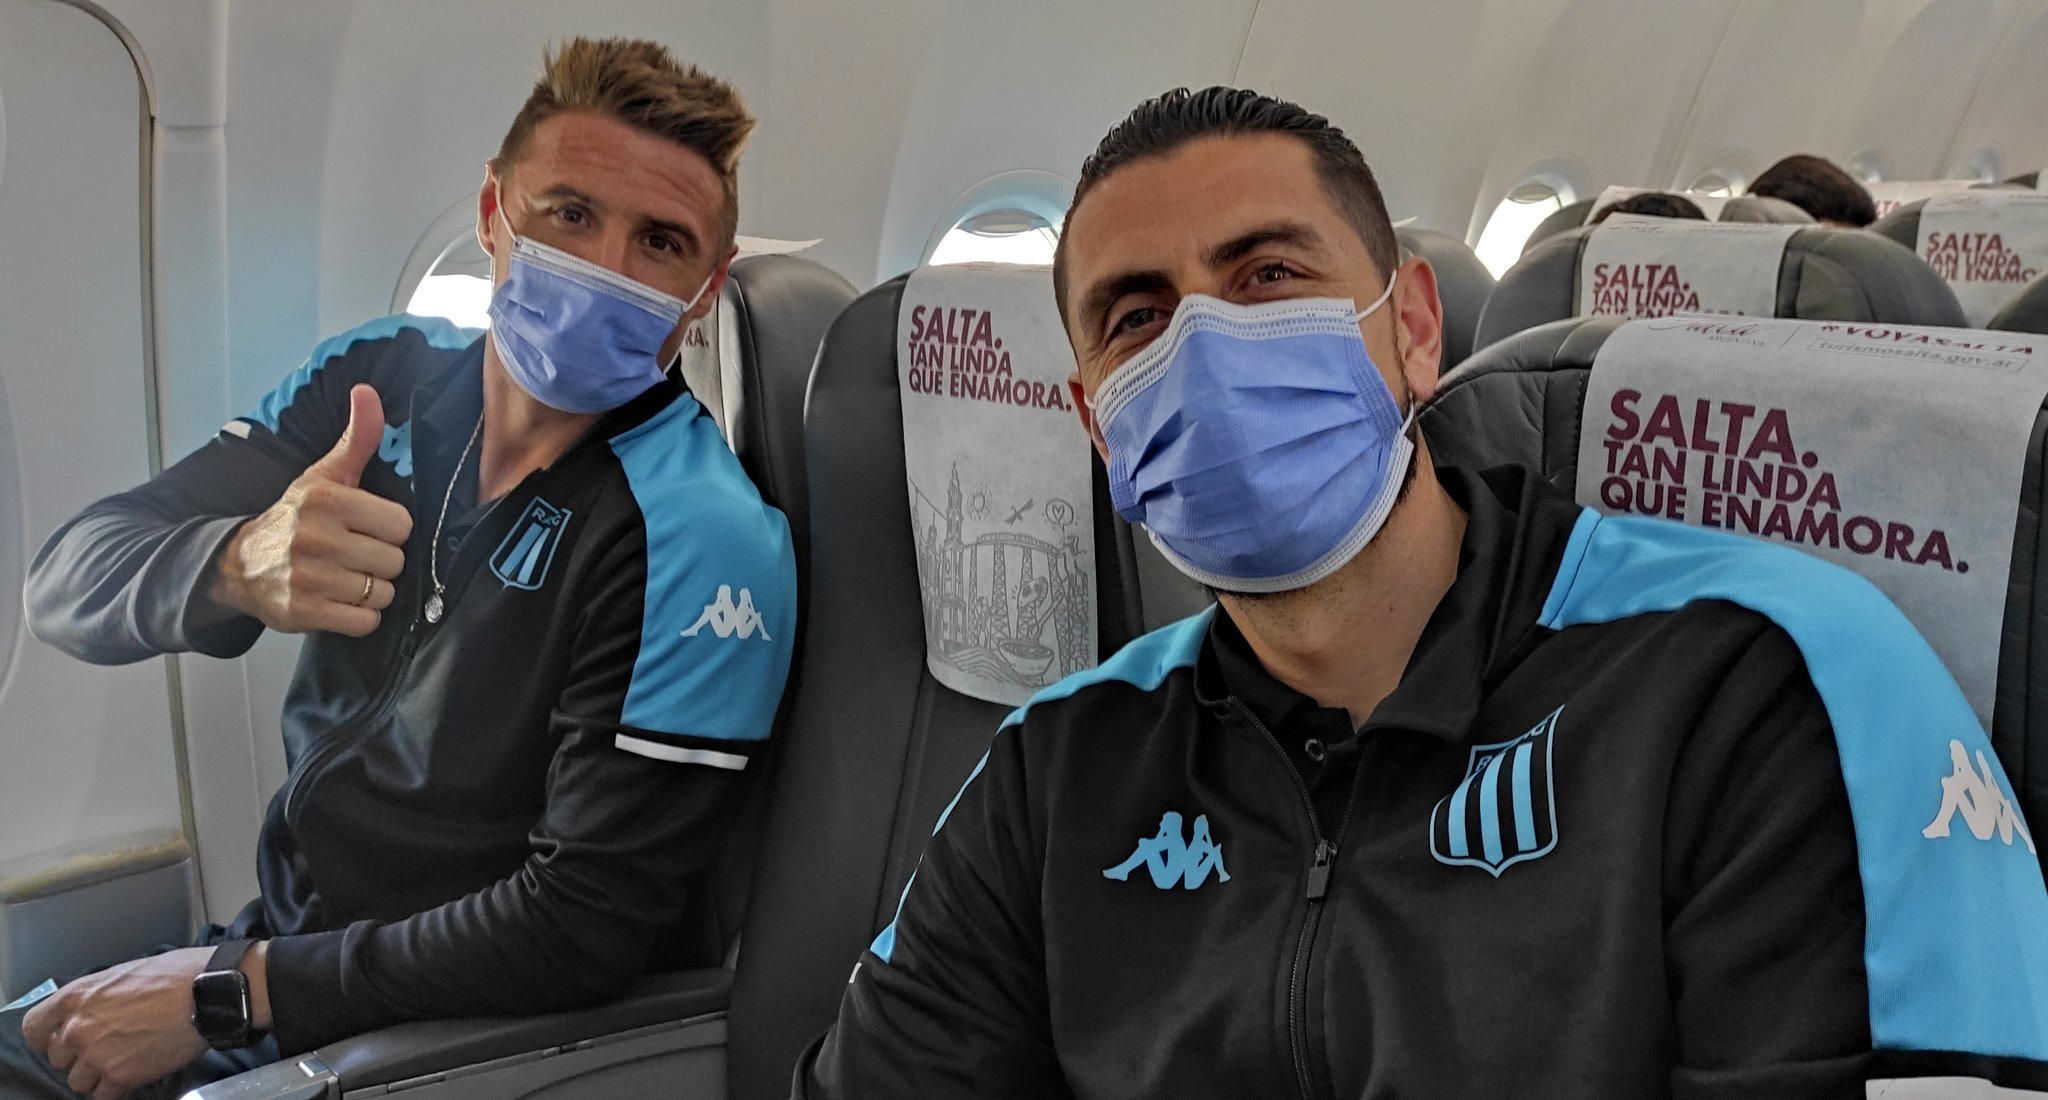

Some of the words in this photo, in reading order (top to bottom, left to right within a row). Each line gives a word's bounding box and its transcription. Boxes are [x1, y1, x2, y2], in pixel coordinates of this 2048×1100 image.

[1927, 232, 2012, 254] SALTA.
[1594, 263, 1690, 291] SALTA.
[1592, 289, 1628, 307] TAN
[1635, 290, 1700, 312] LINDA
[910, 304, 1003, 349] SALTA.
[908, 341, 944, 370] TAN
[950, 346, 1013, 378] LINDA
[1818, 341, 2017, 369] turismosalta.gov.ar
[908, 369, 943, 396] QUE
[950, 373, 1072, 412] ENAMORA.
[1606, 388, 1818, 469] SALTA.
[1603, 439, 1687, 485] TAN
[1702, 454, 1842, 512] LINDA
[1600, 475, 1687, 521] QUE
[1701, 491, 1969, 574] ENAMORA.
